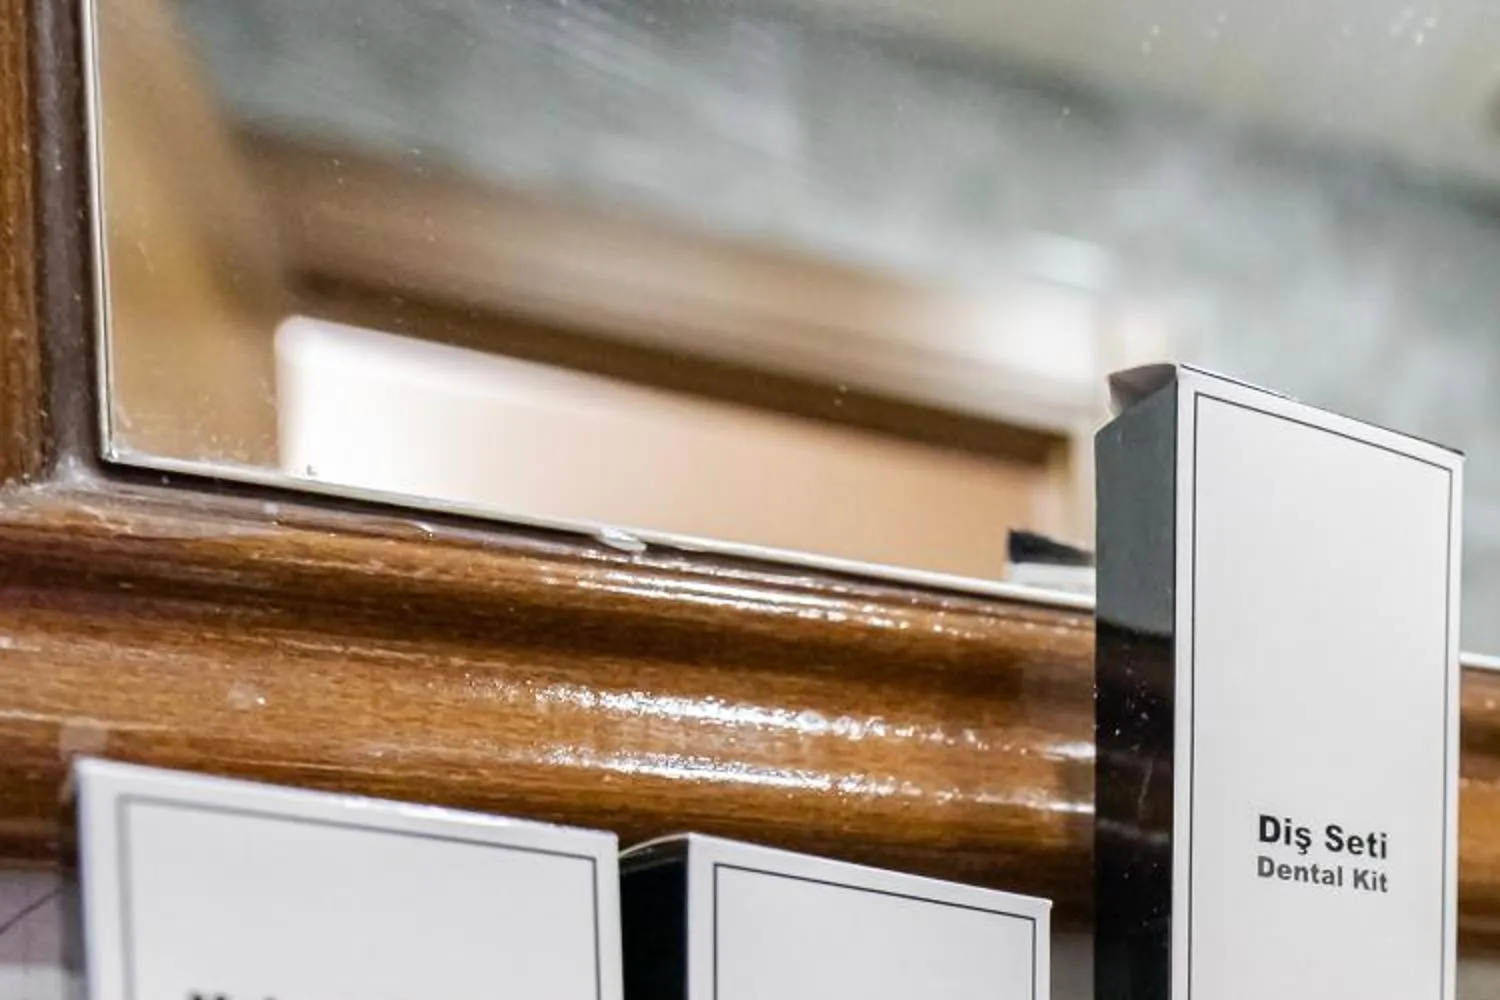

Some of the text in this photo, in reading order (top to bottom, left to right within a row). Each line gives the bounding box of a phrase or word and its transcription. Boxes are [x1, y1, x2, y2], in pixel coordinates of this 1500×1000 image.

[1258, 814, 1388, 860] Diş Seti
[1256, 855, 1388, 893] Dental Kit
